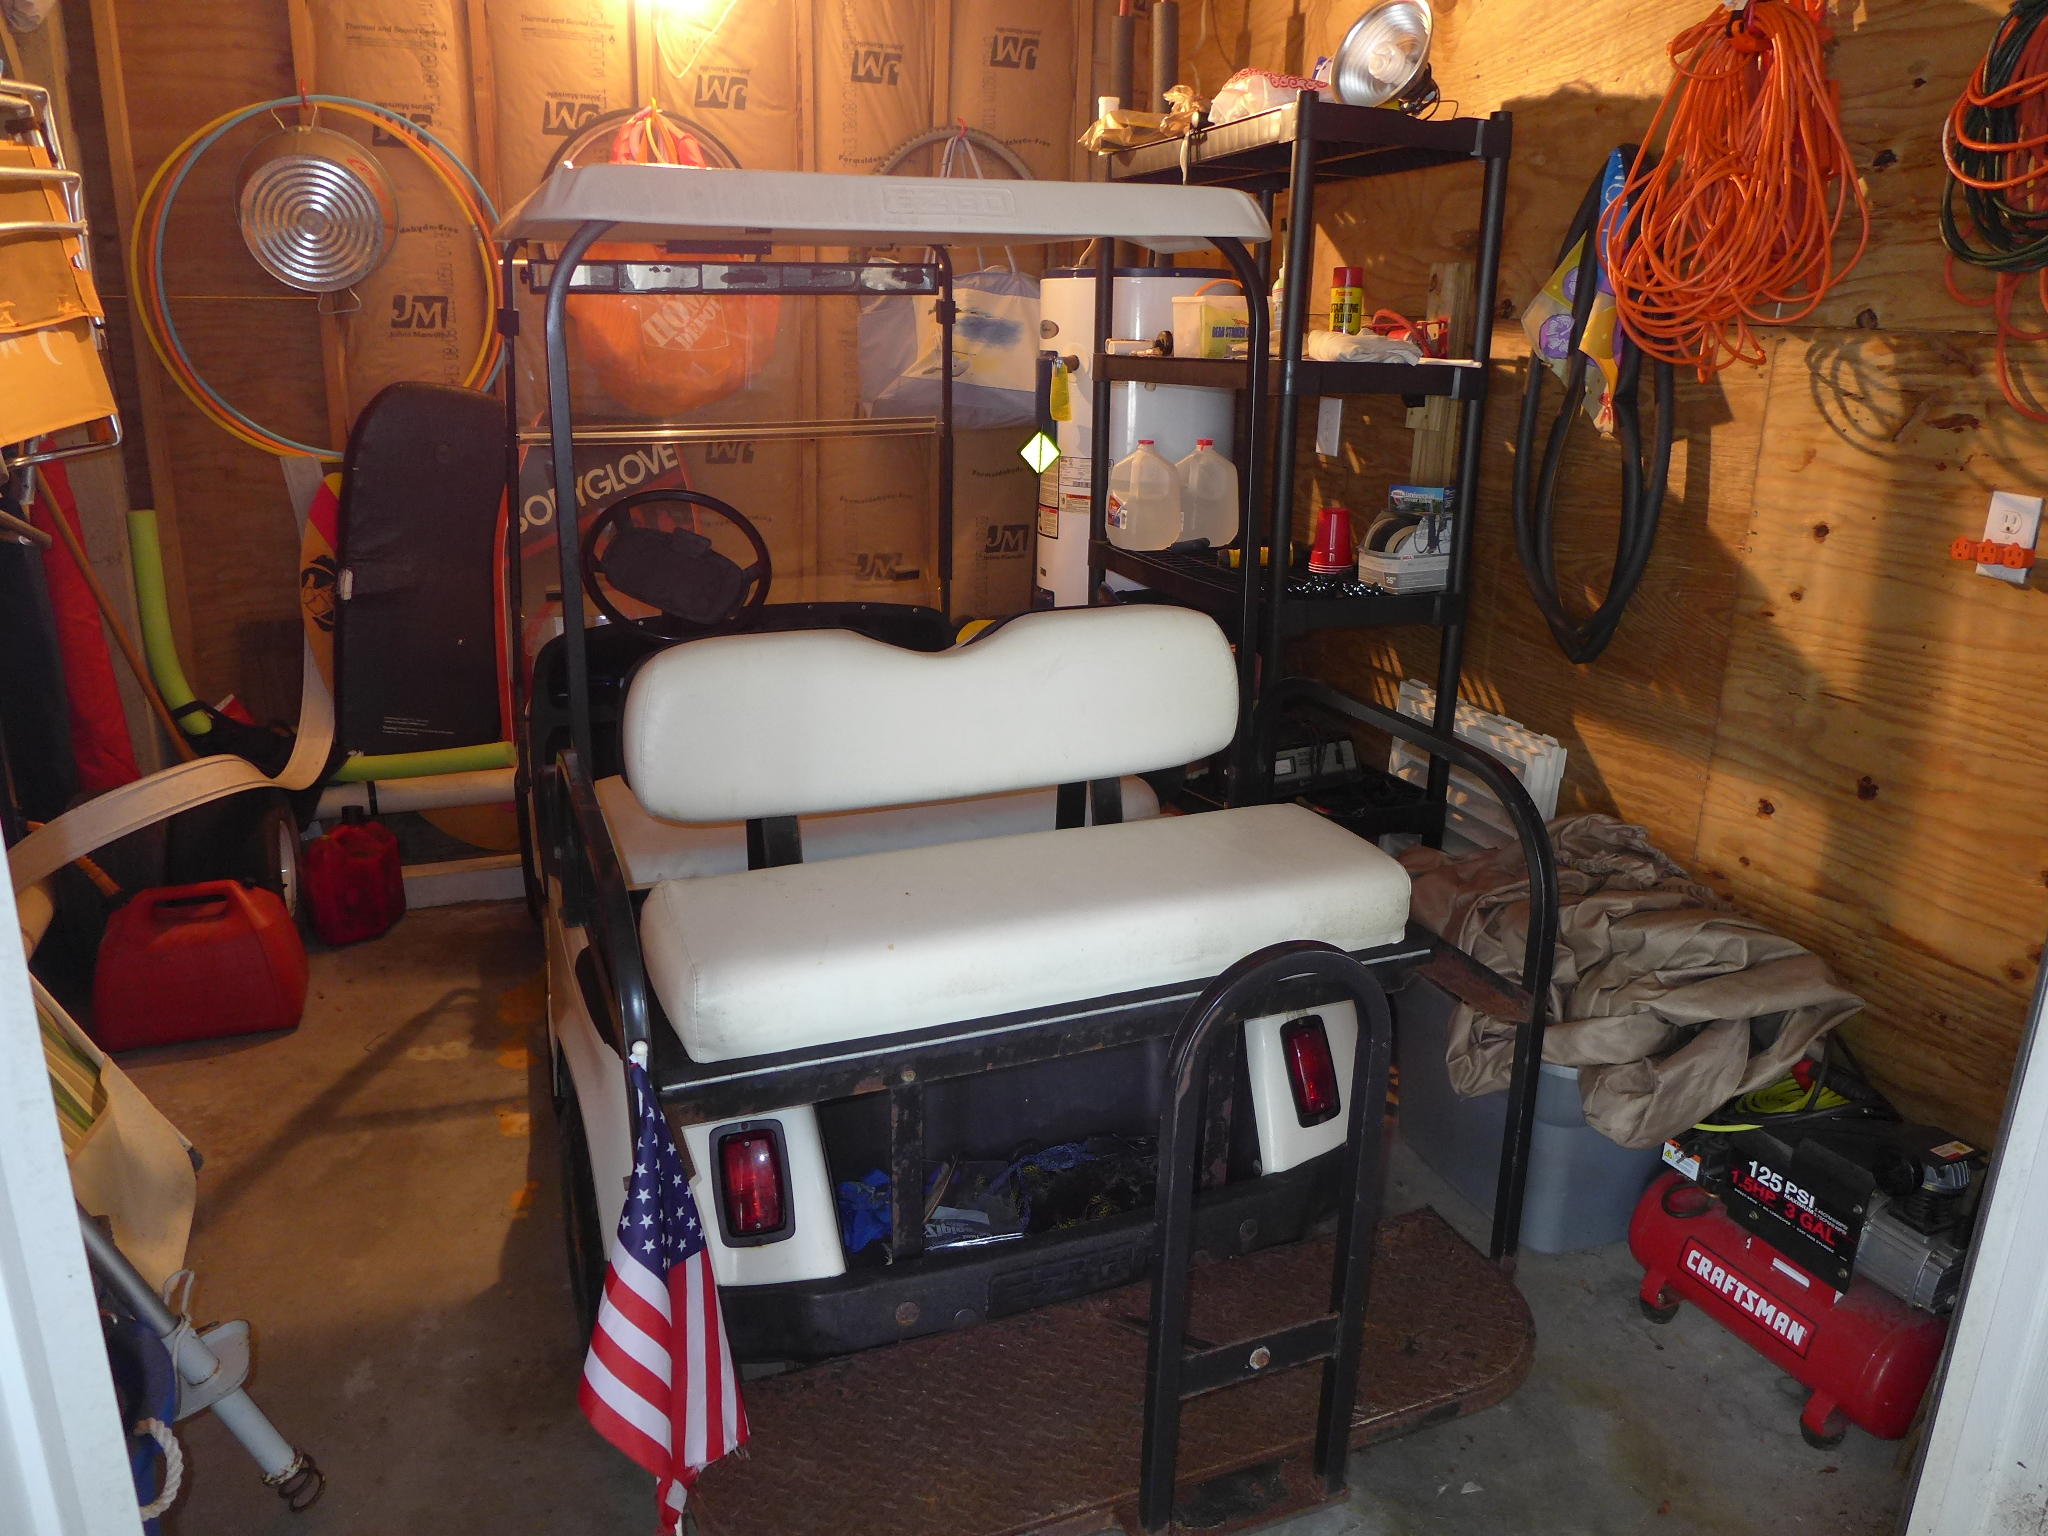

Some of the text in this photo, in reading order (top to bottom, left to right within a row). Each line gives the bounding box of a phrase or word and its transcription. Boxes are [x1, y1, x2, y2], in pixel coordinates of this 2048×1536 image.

[851, 48, 902, 86] JM
[990, 34, 1040, 70] JM
[694, 74, 748, 110] JM
[542, 100, 600, 136] JM
[390, 294, 449, 329] JM
[985, 524, 1029, 554] JM
[1748, 1160, 1783, 1193] 125
[1784, 1180, 1815, 1209] PSI
[1783, 1193, 1815, 1215] MAXIMUM
[1784, 1202, 1796, 1219] 3
[1800, 1213, 1837, 1247] GAL
[1686, 1249, 1806, 1346] CRAFTSMAN
